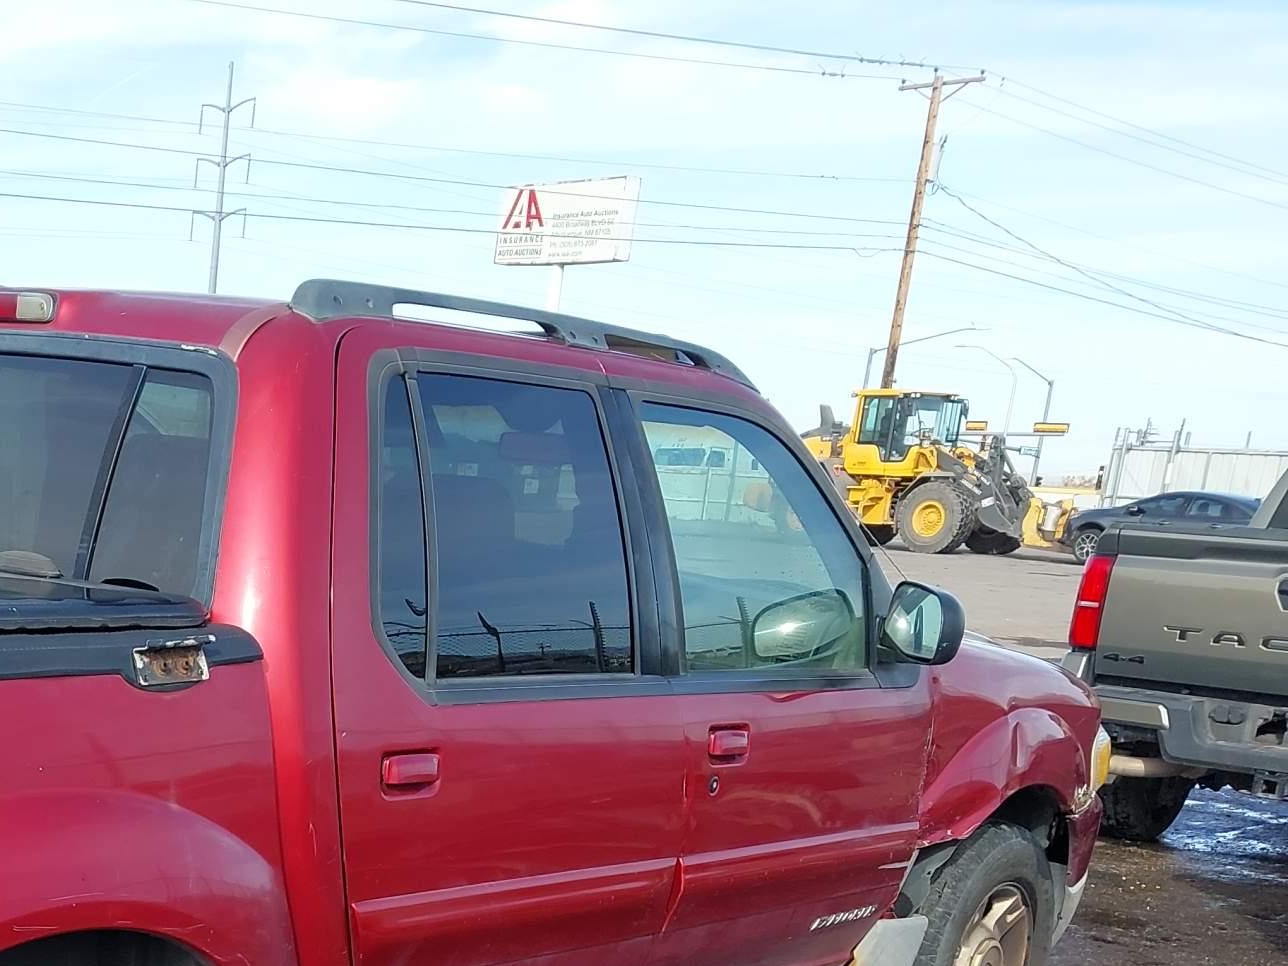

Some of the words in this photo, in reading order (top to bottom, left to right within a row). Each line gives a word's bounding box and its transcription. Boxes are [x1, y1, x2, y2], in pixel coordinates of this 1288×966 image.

[499, 235, 543, 244] INSURANCE
[498, 247, 513, 257] AUTO
[513, 247, 542, 256] AUCTIONS
